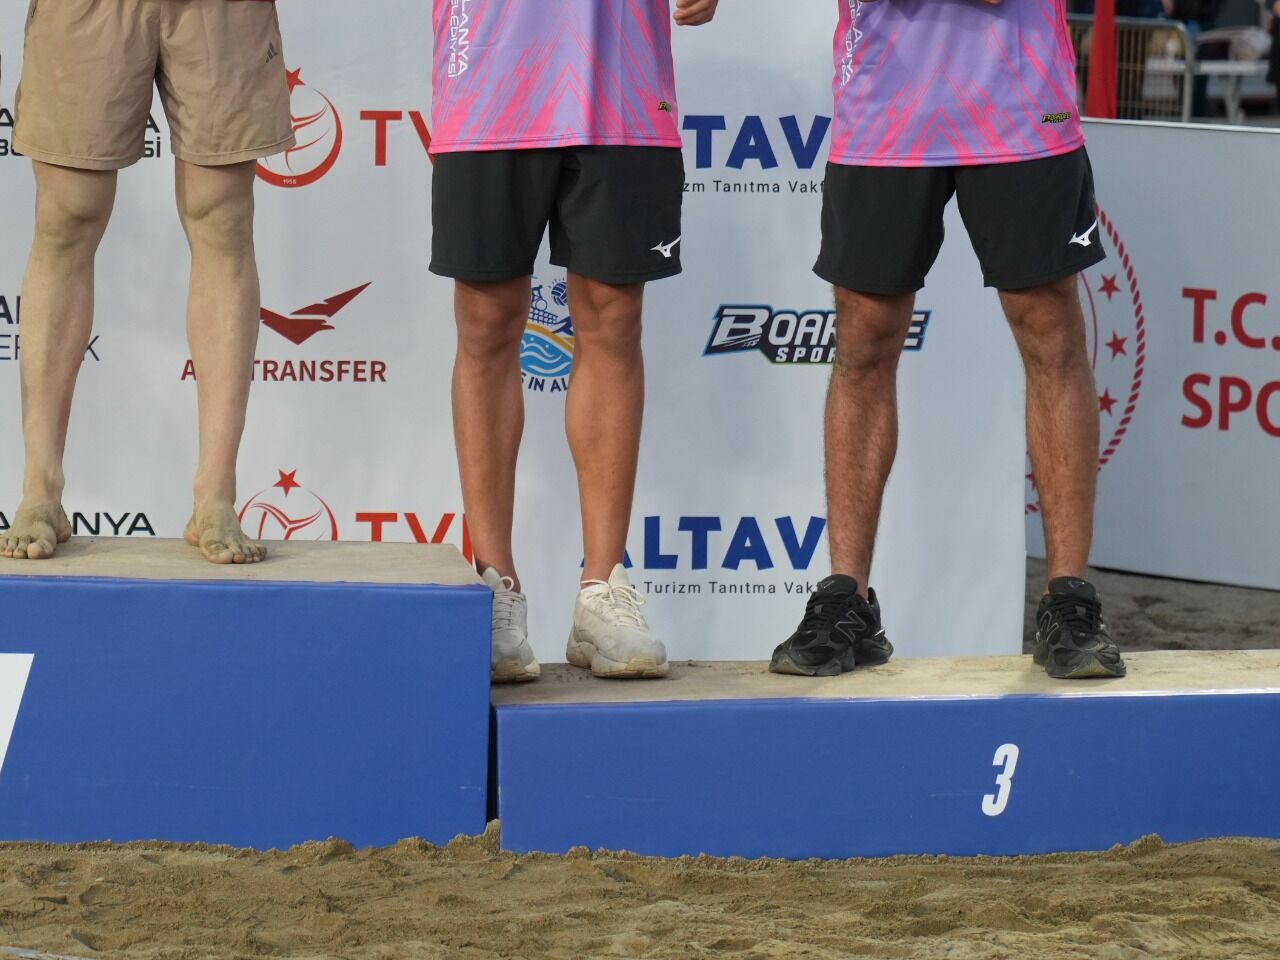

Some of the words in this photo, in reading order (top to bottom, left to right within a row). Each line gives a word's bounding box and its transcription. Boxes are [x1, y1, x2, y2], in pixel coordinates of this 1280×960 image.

[682, 115, 832, 170] TAV
[713, 179, 780, 193] Tanıtma
[581, 515, 827, 570] LTAV
[644, 581, 701, 594] Turizm
[709, 581, 776, 594] Tanıtma
[982, 743, 1019, 816] 3
